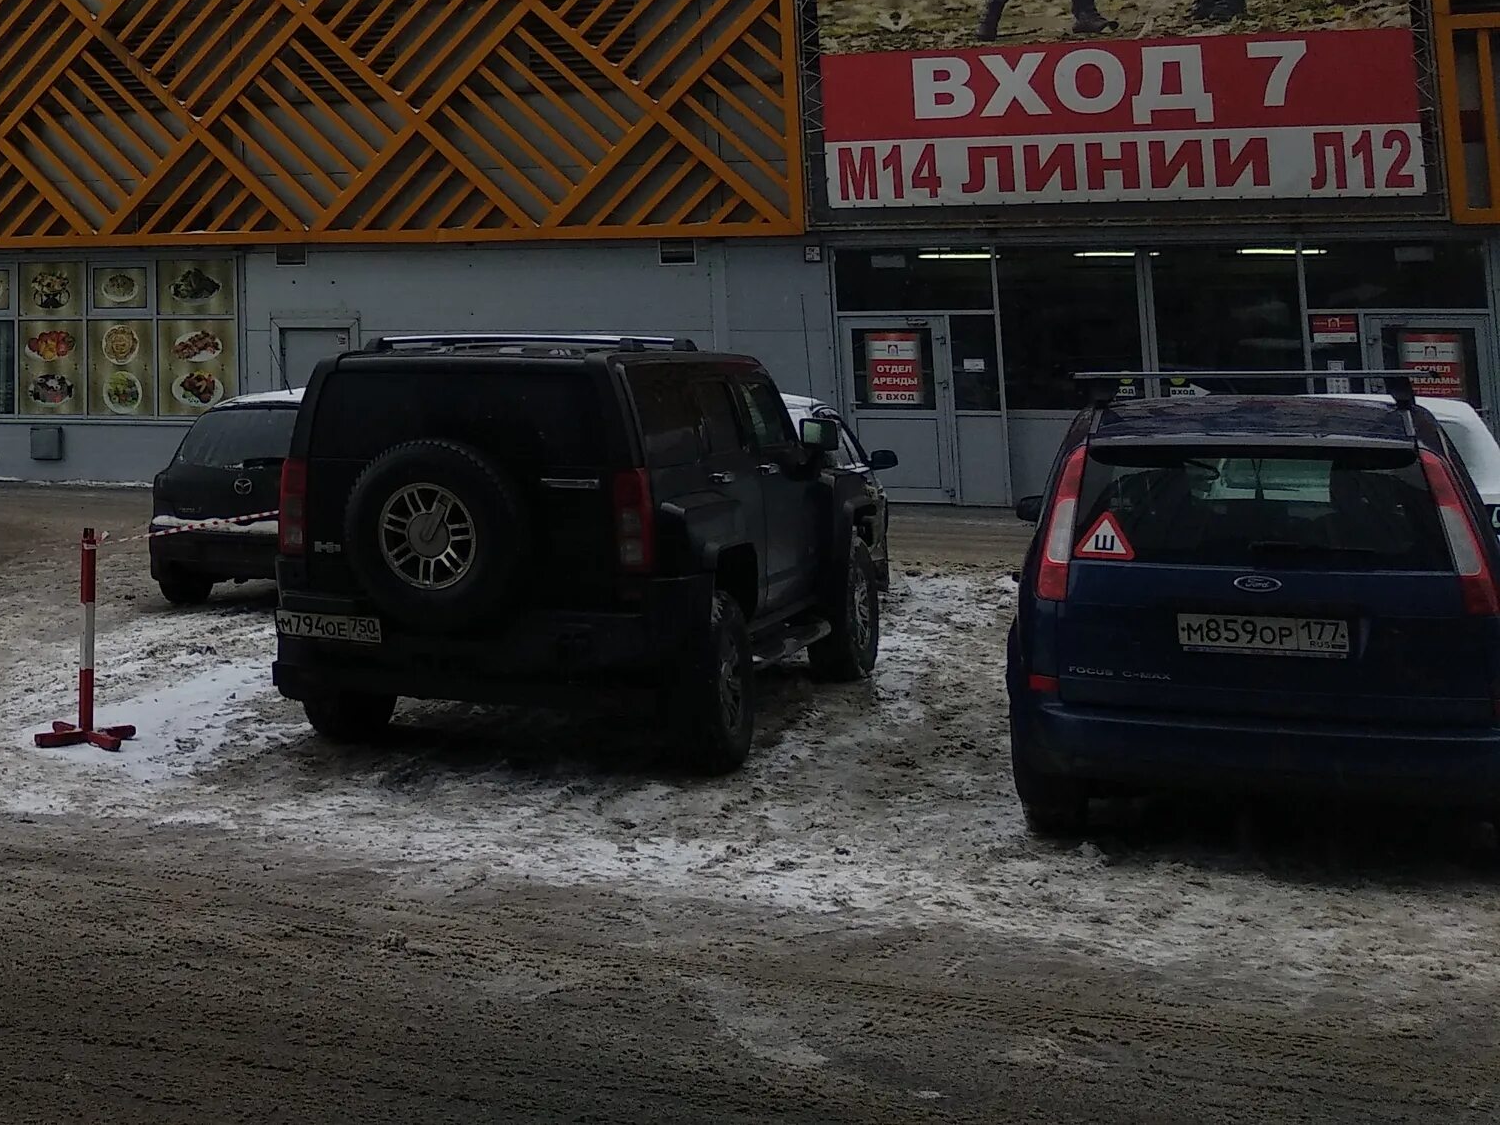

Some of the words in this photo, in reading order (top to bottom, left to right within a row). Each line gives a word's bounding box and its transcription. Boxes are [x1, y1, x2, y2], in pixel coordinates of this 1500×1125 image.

[911, 44, 1214, 124] ВХОД
[1246, 40, 1308, 107] 7
[837, 144, 941, 201] М14
[961, 137, 1270, 193] ЛИНИИ
[1311, 130, 1414, 190] Л12
[876, 365, 912, 374] ОТДЕЛ
[872, 377, 918, 386] АРЕНДЫ
[876, 393, 883, 401] 6
[886, 393, 915, 401] ВХОД
[1094, 534, 1115, 551] Ш
[1068, 666, 1114, 676] FOCUS
